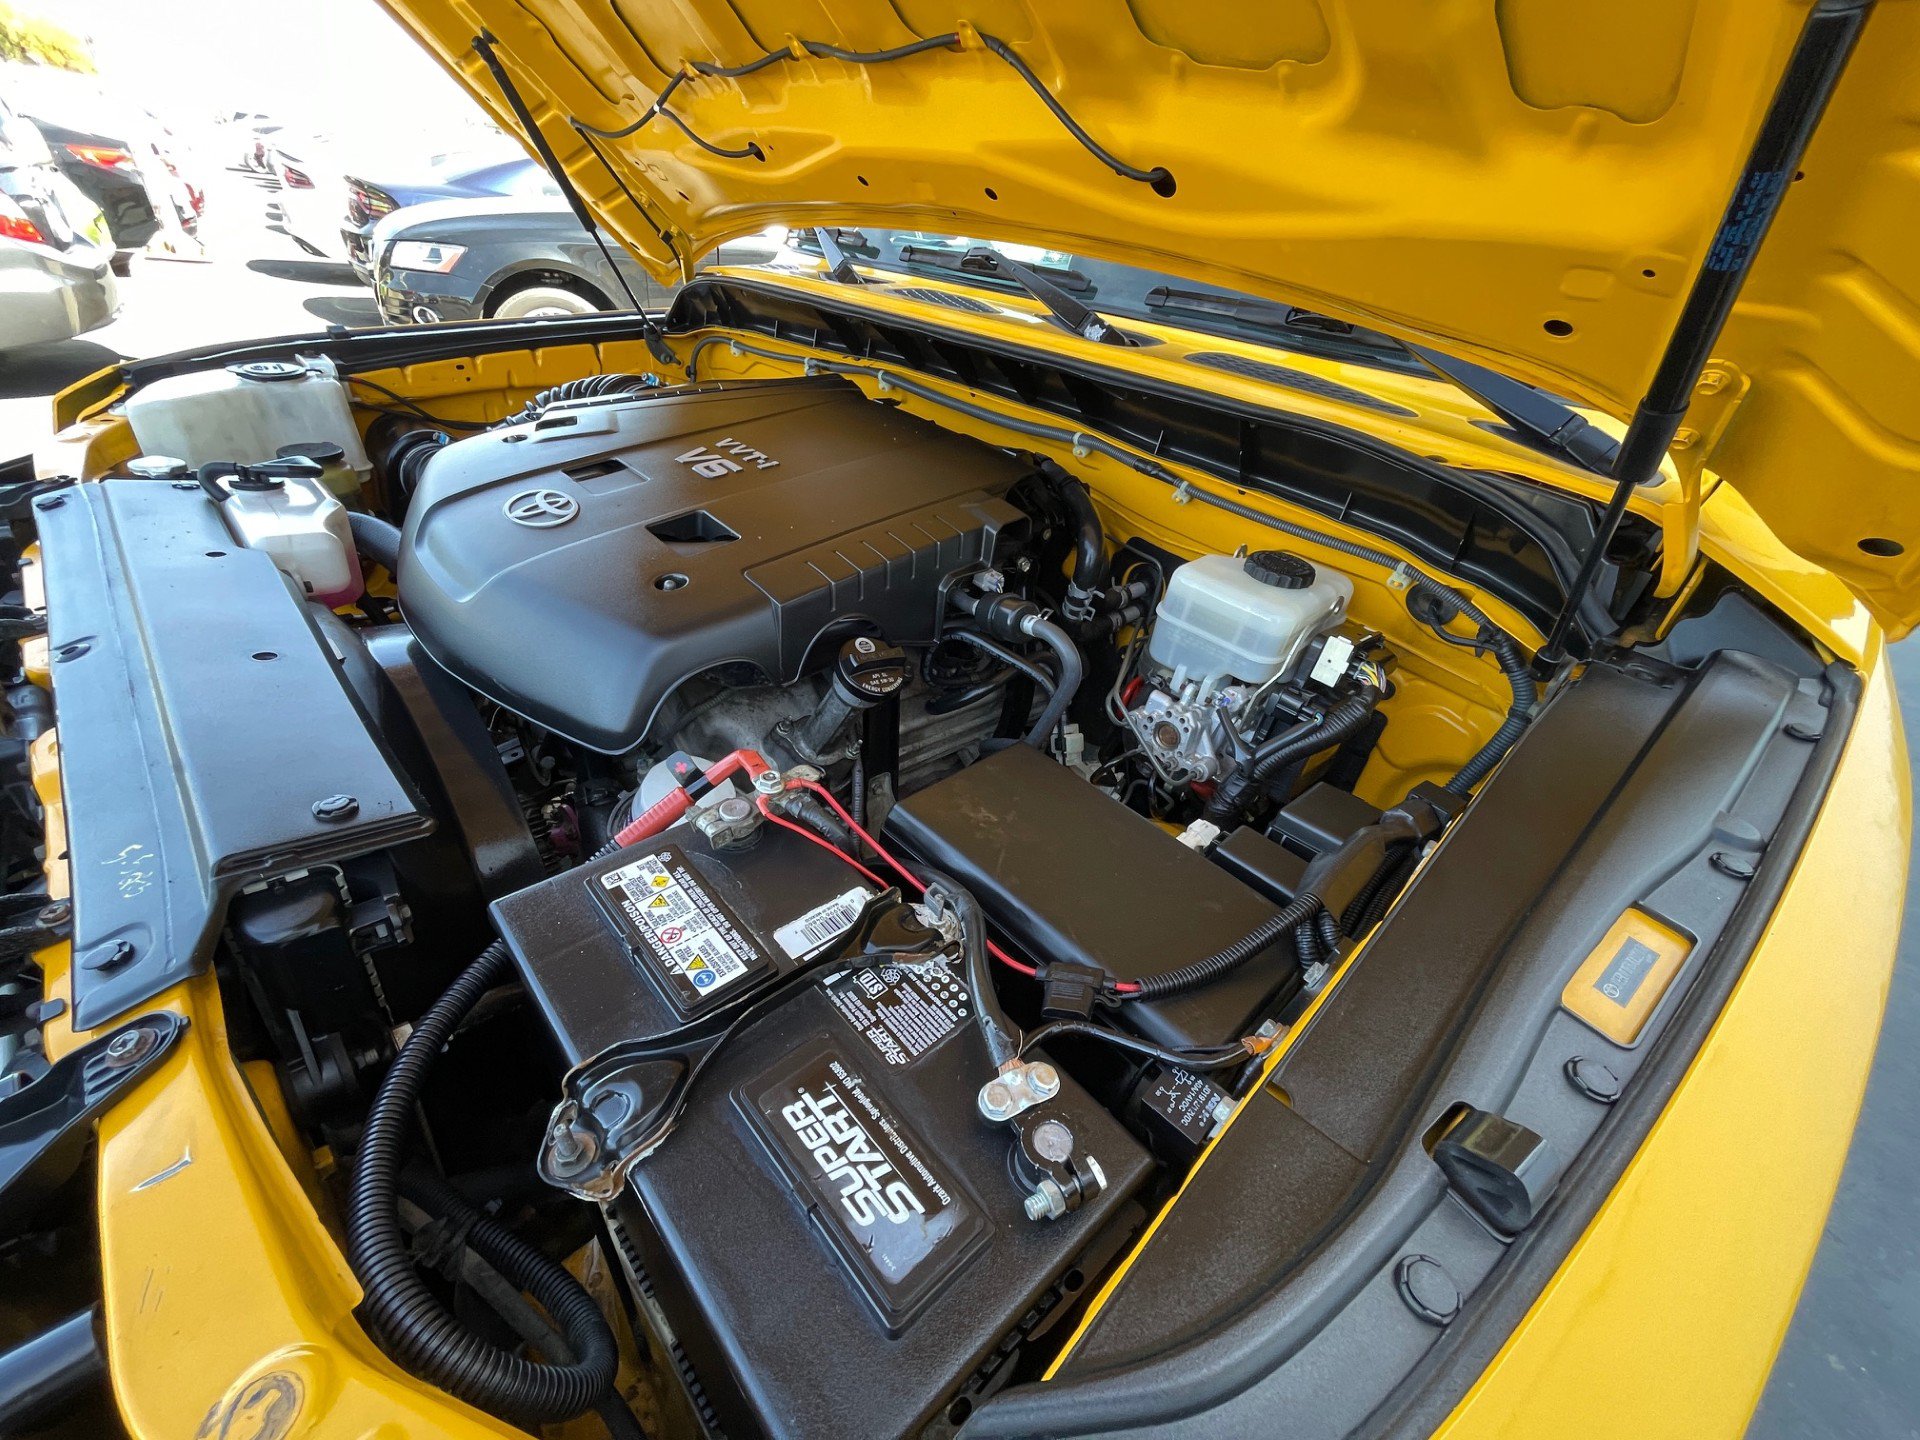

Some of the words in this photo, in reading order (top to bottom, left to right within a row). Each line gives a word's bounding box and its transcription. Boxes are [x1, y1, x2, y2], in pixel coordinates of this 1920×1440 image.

[674, 446, 744, 478] V6
[858, 970, 884, 995] STD
[863, 1028, 900, 1065] SUPER
[869, 1024, 911, 1065] START
[828, 1060, 848, 1080] 65802
[782, 1105, 875, 1226] SUPER
[802, 1093, 925, 1224] START
[902, 1149, 937, 1187] Automotive
[930, 1182, 952, 1205] Ozark
